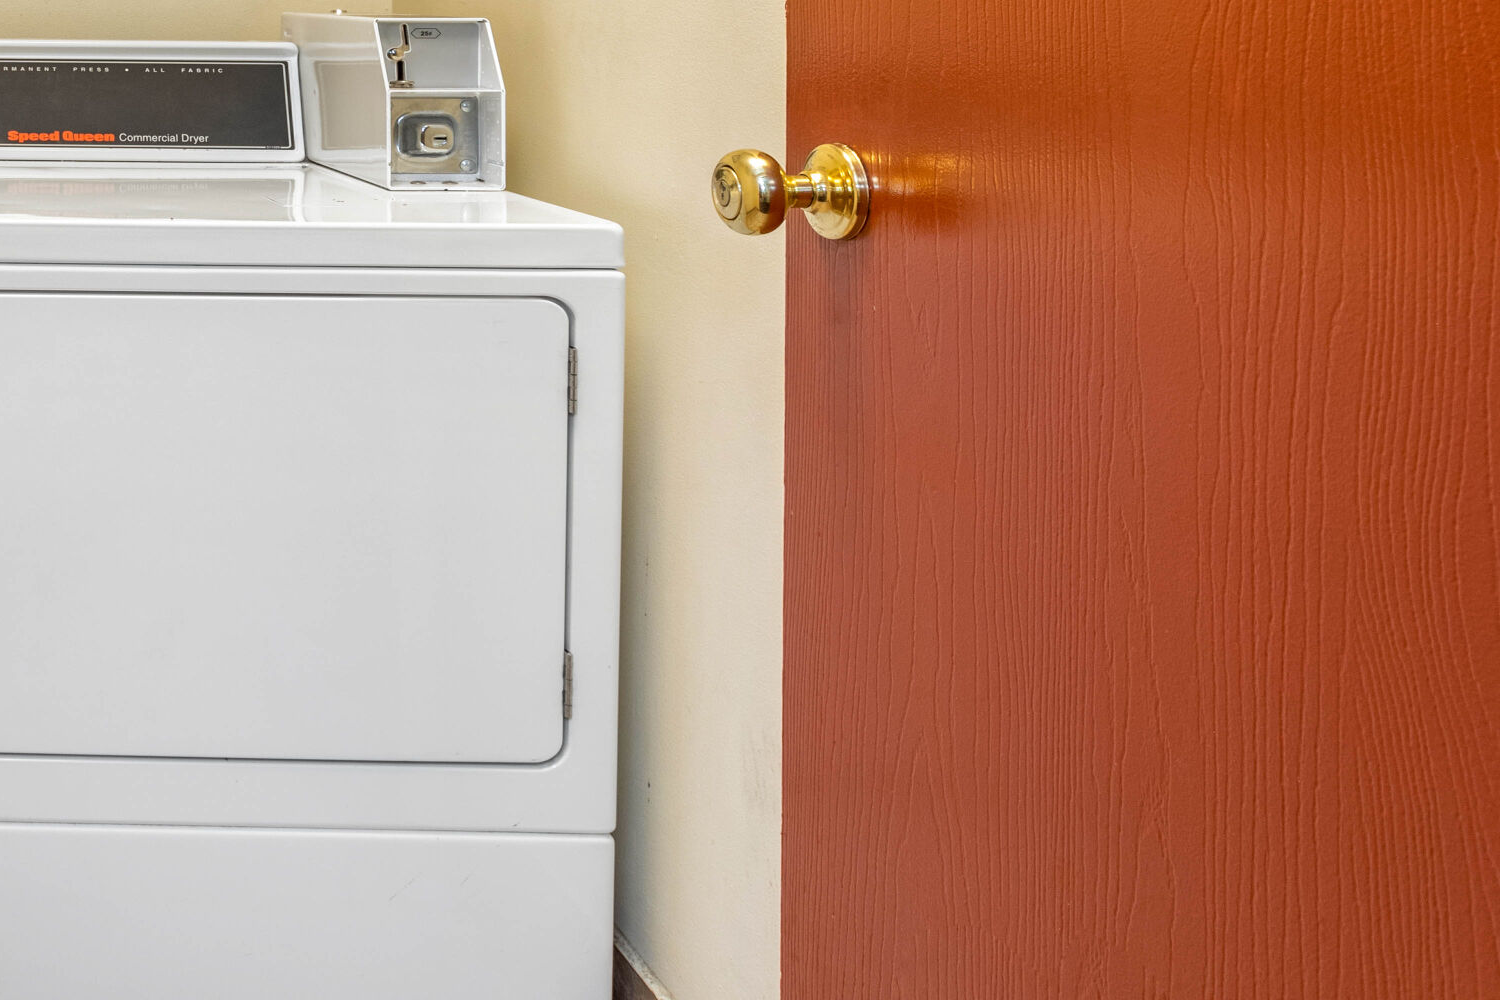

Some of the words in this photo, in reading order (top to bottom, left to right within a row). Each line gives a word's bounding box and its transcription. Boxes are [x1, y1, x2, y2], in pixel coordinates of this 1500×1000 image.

[7, 130, 60, 143] Speed
[62, 131, 115, 142] Queen
[119, 133, 179, 143] Commercial
[182, 133, 209, 144] Dryer
